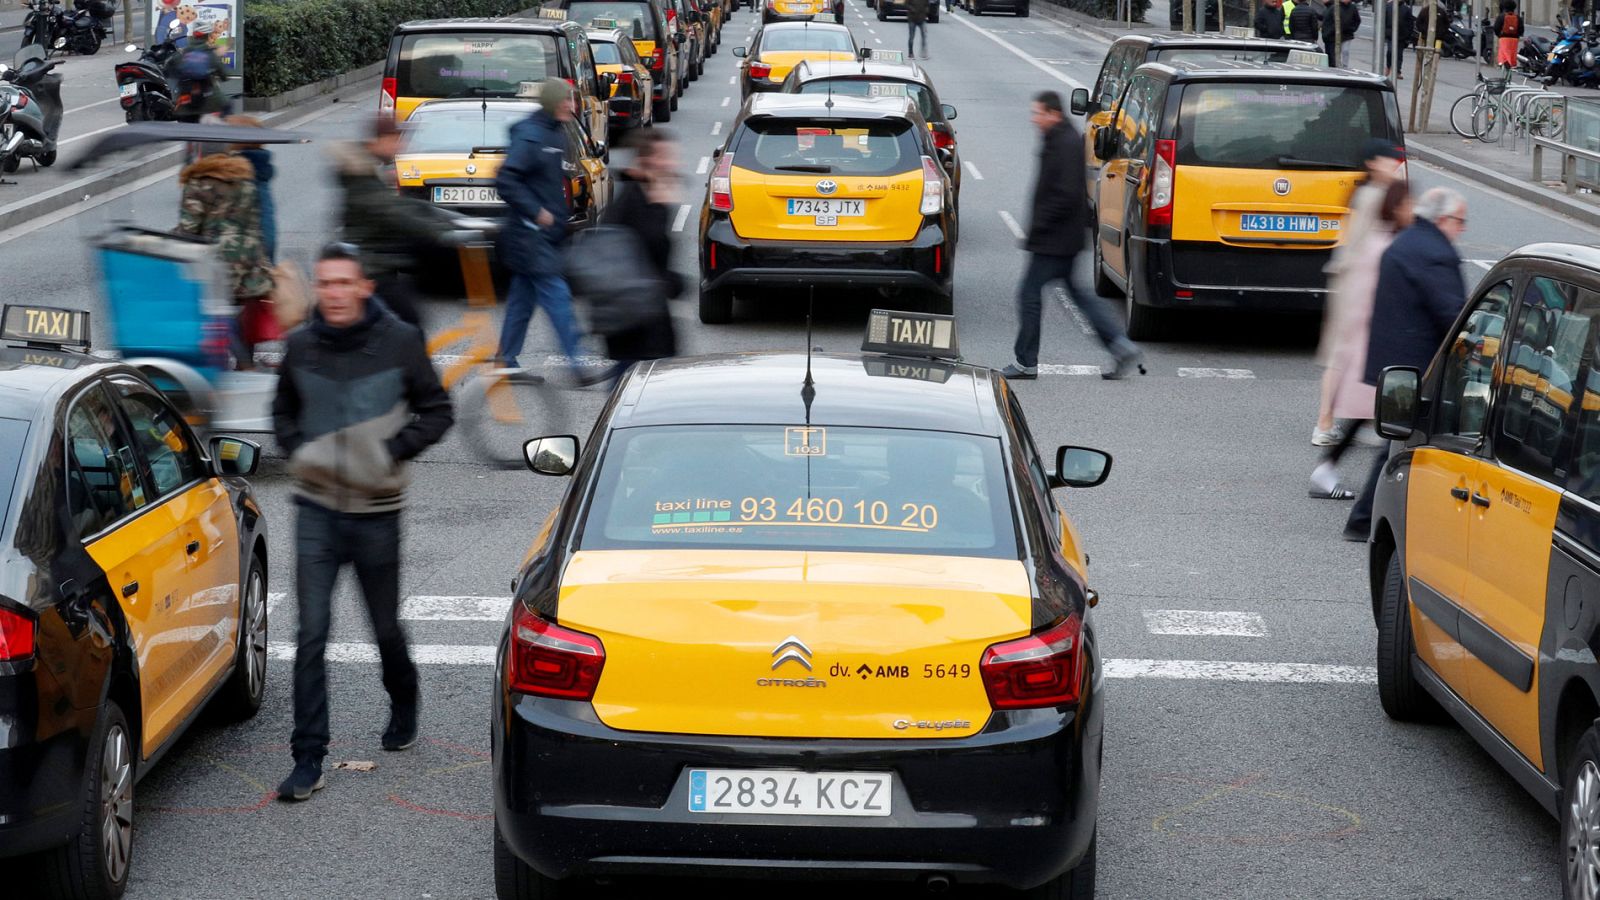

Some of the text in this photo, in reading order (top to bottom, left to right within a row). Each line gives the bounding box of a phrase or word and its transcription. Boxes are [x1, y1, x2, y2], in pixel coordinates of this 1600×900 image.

[546, 9, 563, 18] TAXI
[1301, 53, 1320, 65] TAXI
[881, 85, 899, 96] TAXI
[443, 189, 475, 201] 6210
[796, 201, 861, 214] 7343 JTX
[817, 216, 836, 225] SP
[1250, 216, 1339, 231] 4318 HWM SP
[26, 309, 70, 337] TAXI
[891, 318, 932, 345] TAXI
[793, 429, 817, 446] T
[795, 446, 820, 454] 103
[656, 497, 938, 529] taxi line 93 460 10 20
[652, 526, 743, 535] www.taxiline.es
[829, 662, 971, 679] dv. AMB 5649
[713, 776, 802, 808] 2834
[816, 778, 883, 810] KCZ
